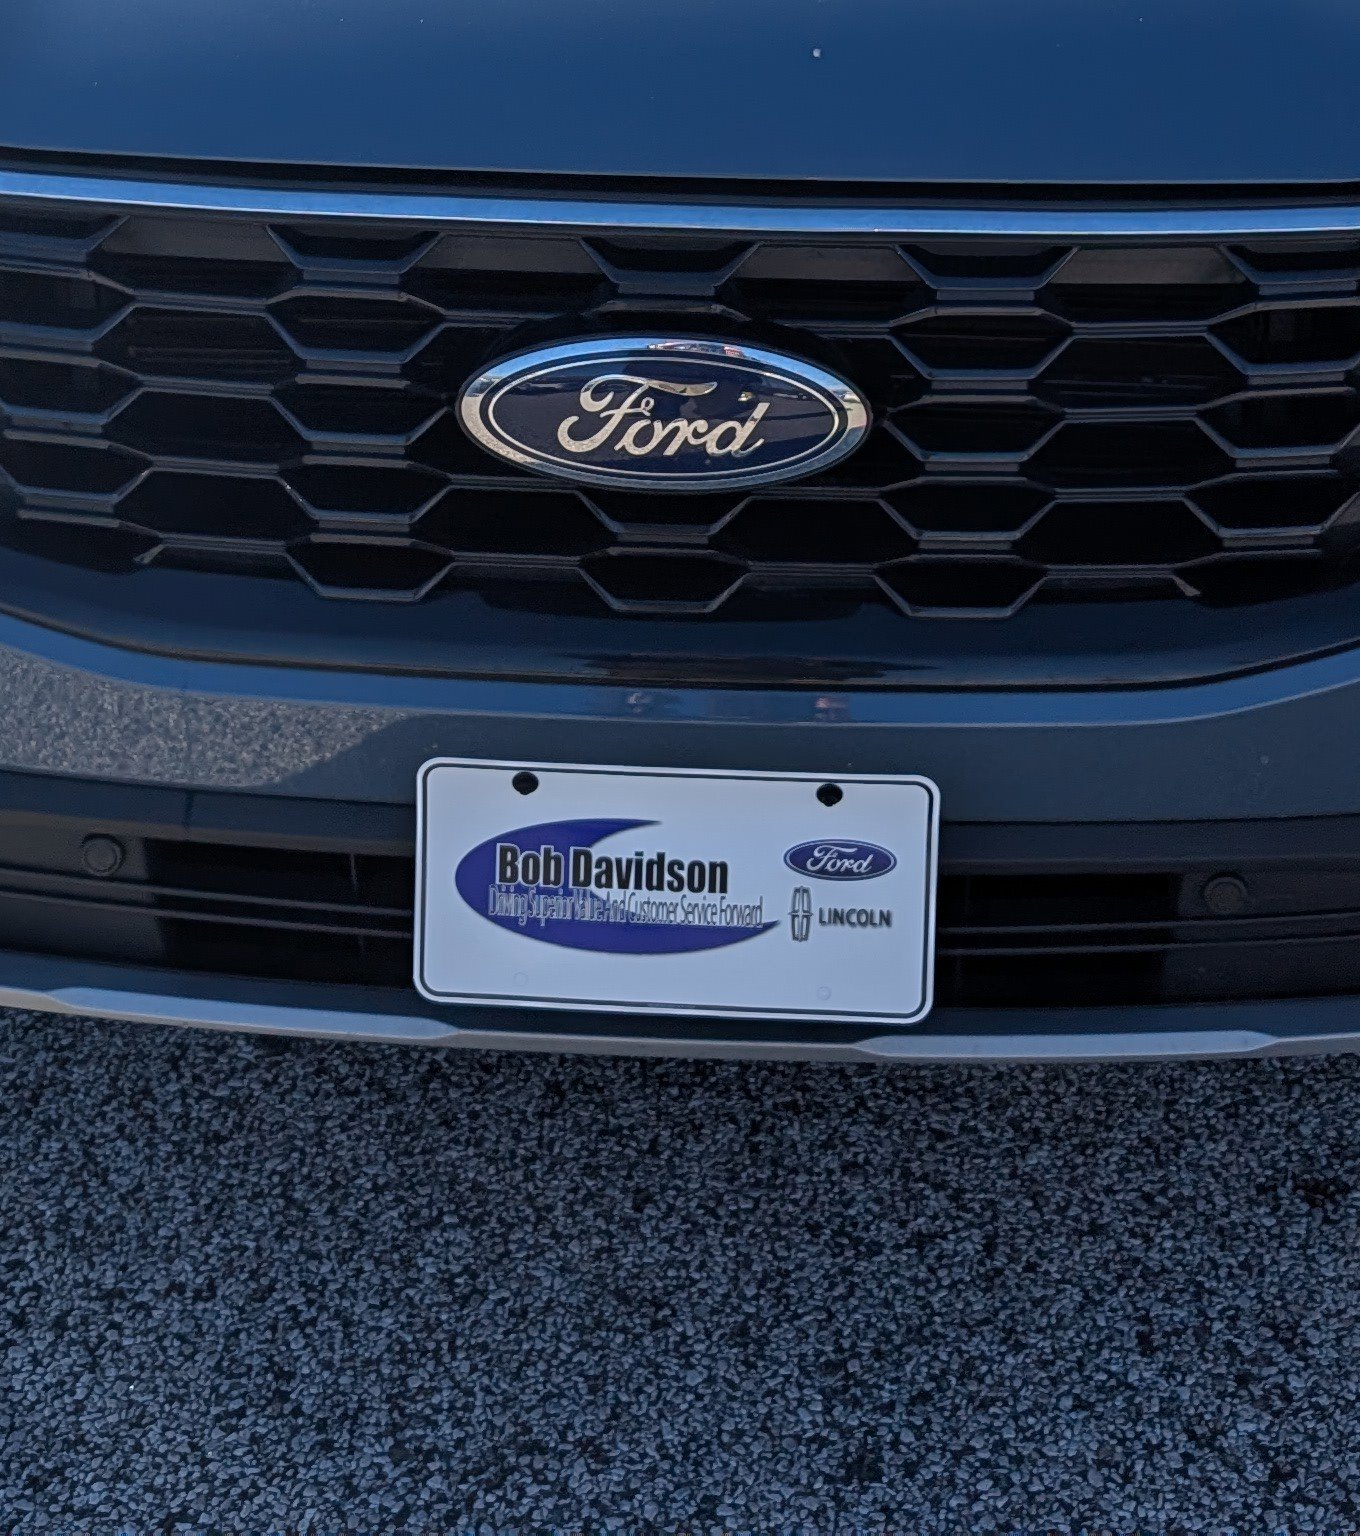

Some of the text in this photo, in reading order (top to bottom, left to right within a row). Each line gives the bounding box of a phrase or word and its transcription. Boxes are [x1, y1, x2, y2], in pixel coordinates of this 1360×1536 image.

[557, 373, 771, 457] Ford
[497, 844, 728, 894] Bob Davidson
[805, 844, 874, 873] Ford
[627, 892, 679, 924] Customer
[680, 894, 717, 925] Service
[719, 896, 764, 928] Forward
[819, 907, 892, 928] LINCOLN
